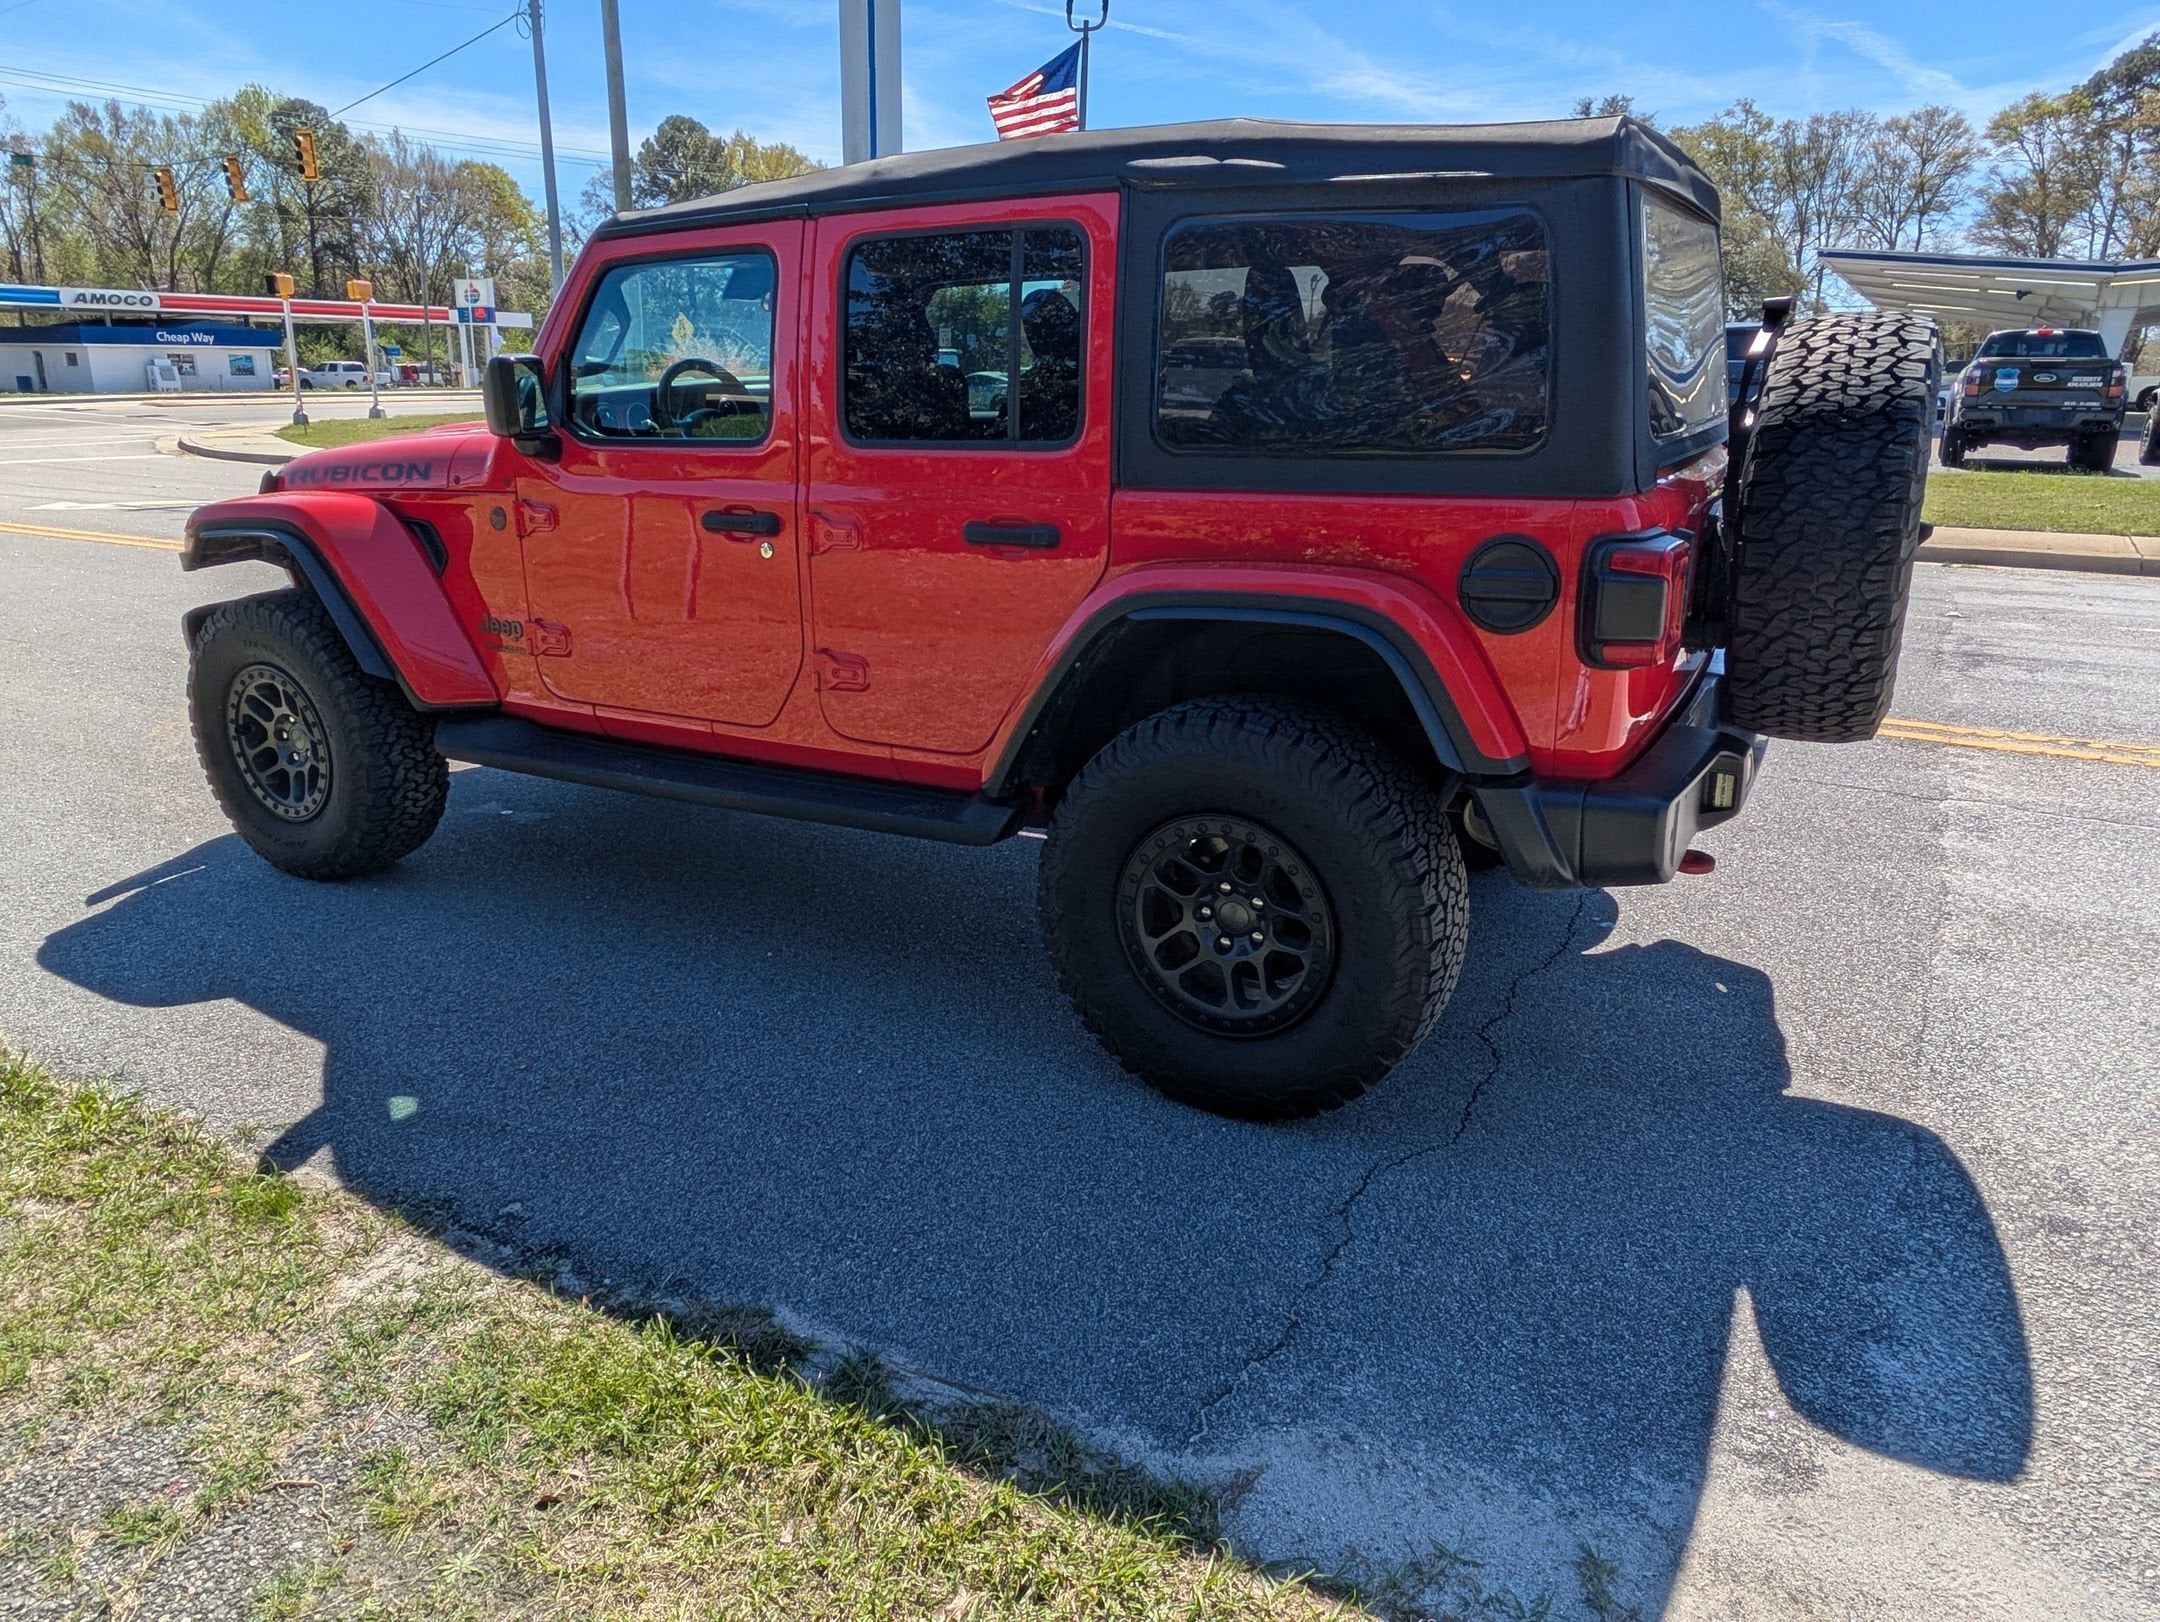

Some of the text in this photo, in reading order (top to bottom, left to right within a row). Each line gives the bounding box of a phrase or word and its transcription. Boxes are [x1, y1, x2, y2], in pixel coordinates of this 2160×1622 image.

[73, 292, 154, 307] AMOCO
[156, 331, 215, 345] Cheap Way
[287, 461, 432, 484] RUBICON
[478, 611, 524, 642] Jeep
